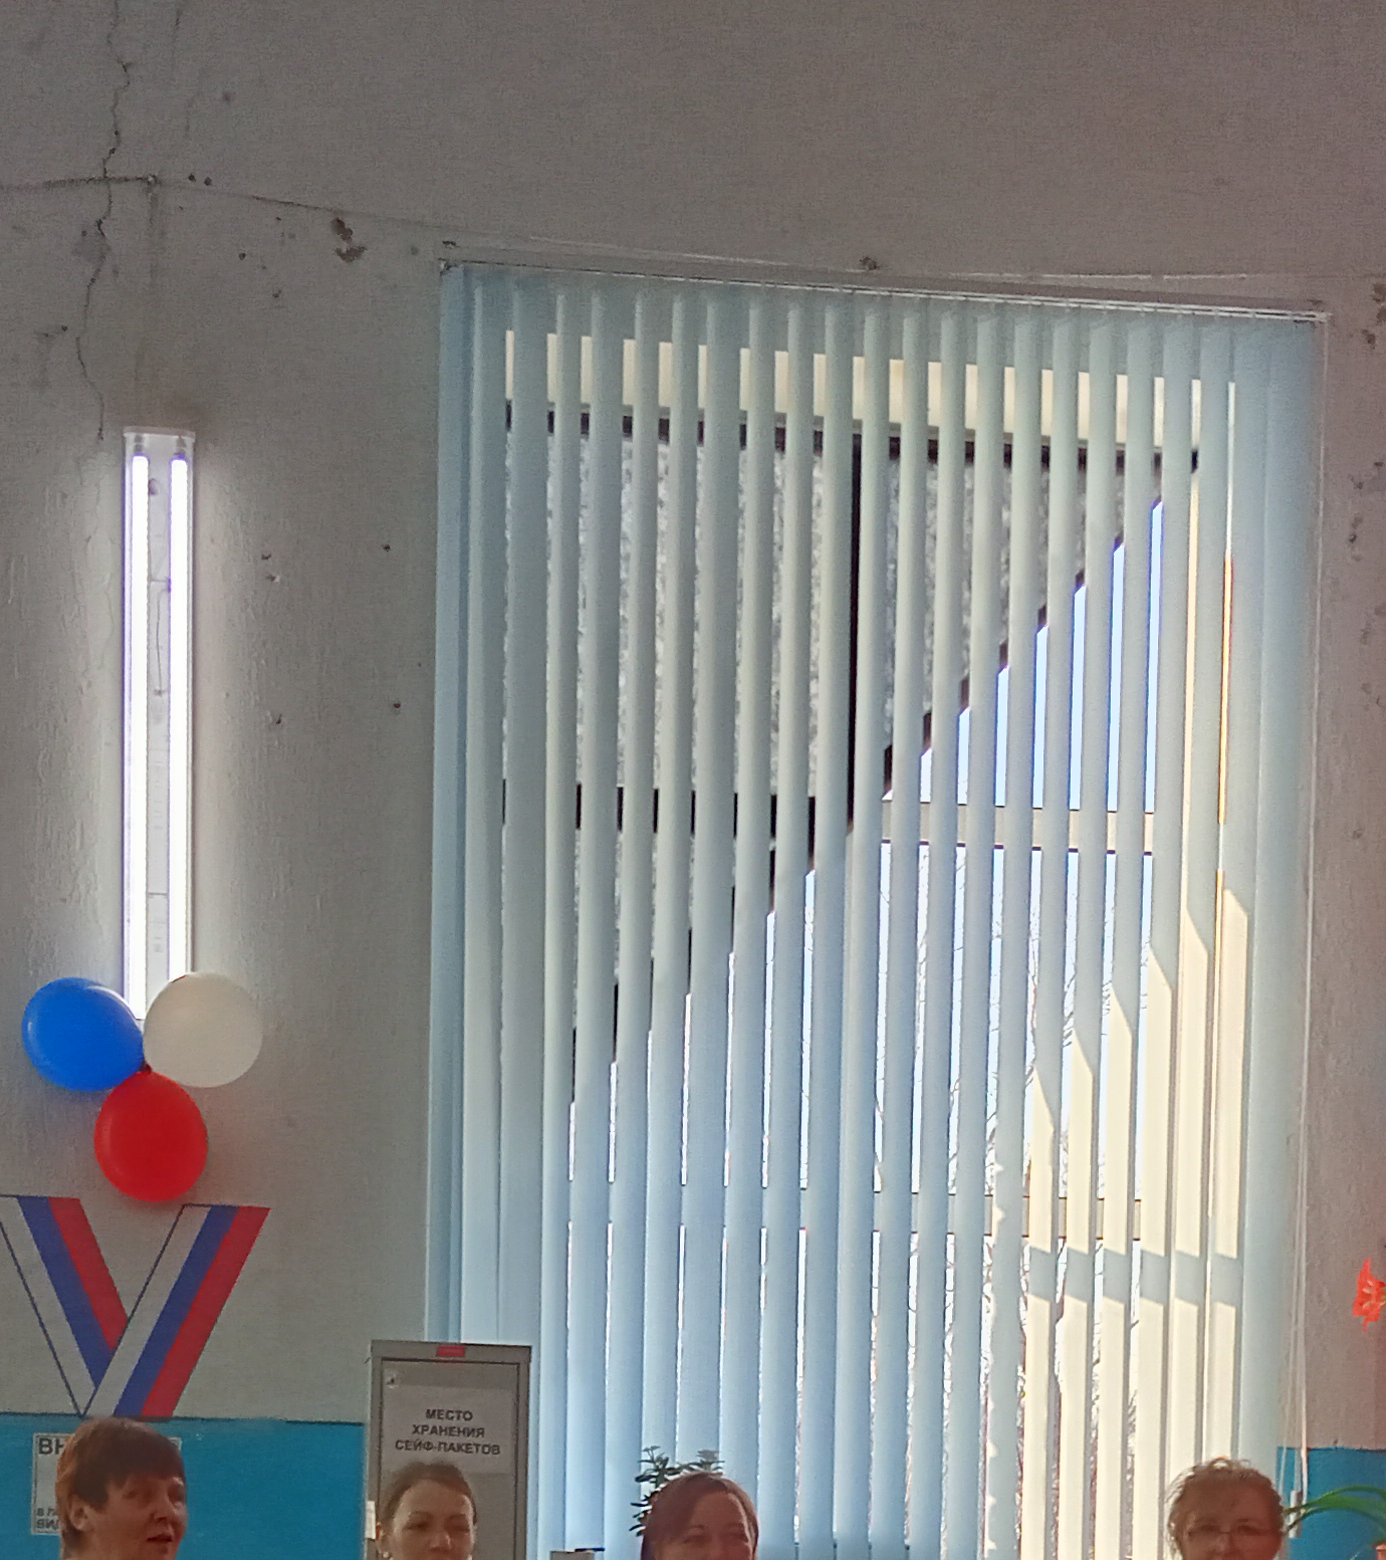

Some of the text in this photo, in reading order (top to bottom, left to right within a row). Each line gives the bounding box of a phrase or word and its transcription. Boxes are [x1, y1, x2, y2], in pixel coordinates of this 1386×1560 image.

[425, 1408, 474, 1422] МЕСТО
[411, 1424, 486, 1438] ХРАНЕНИЯ
[394, 1438, 501, 1456] СЕЙФ-ПАКЕТОВ
